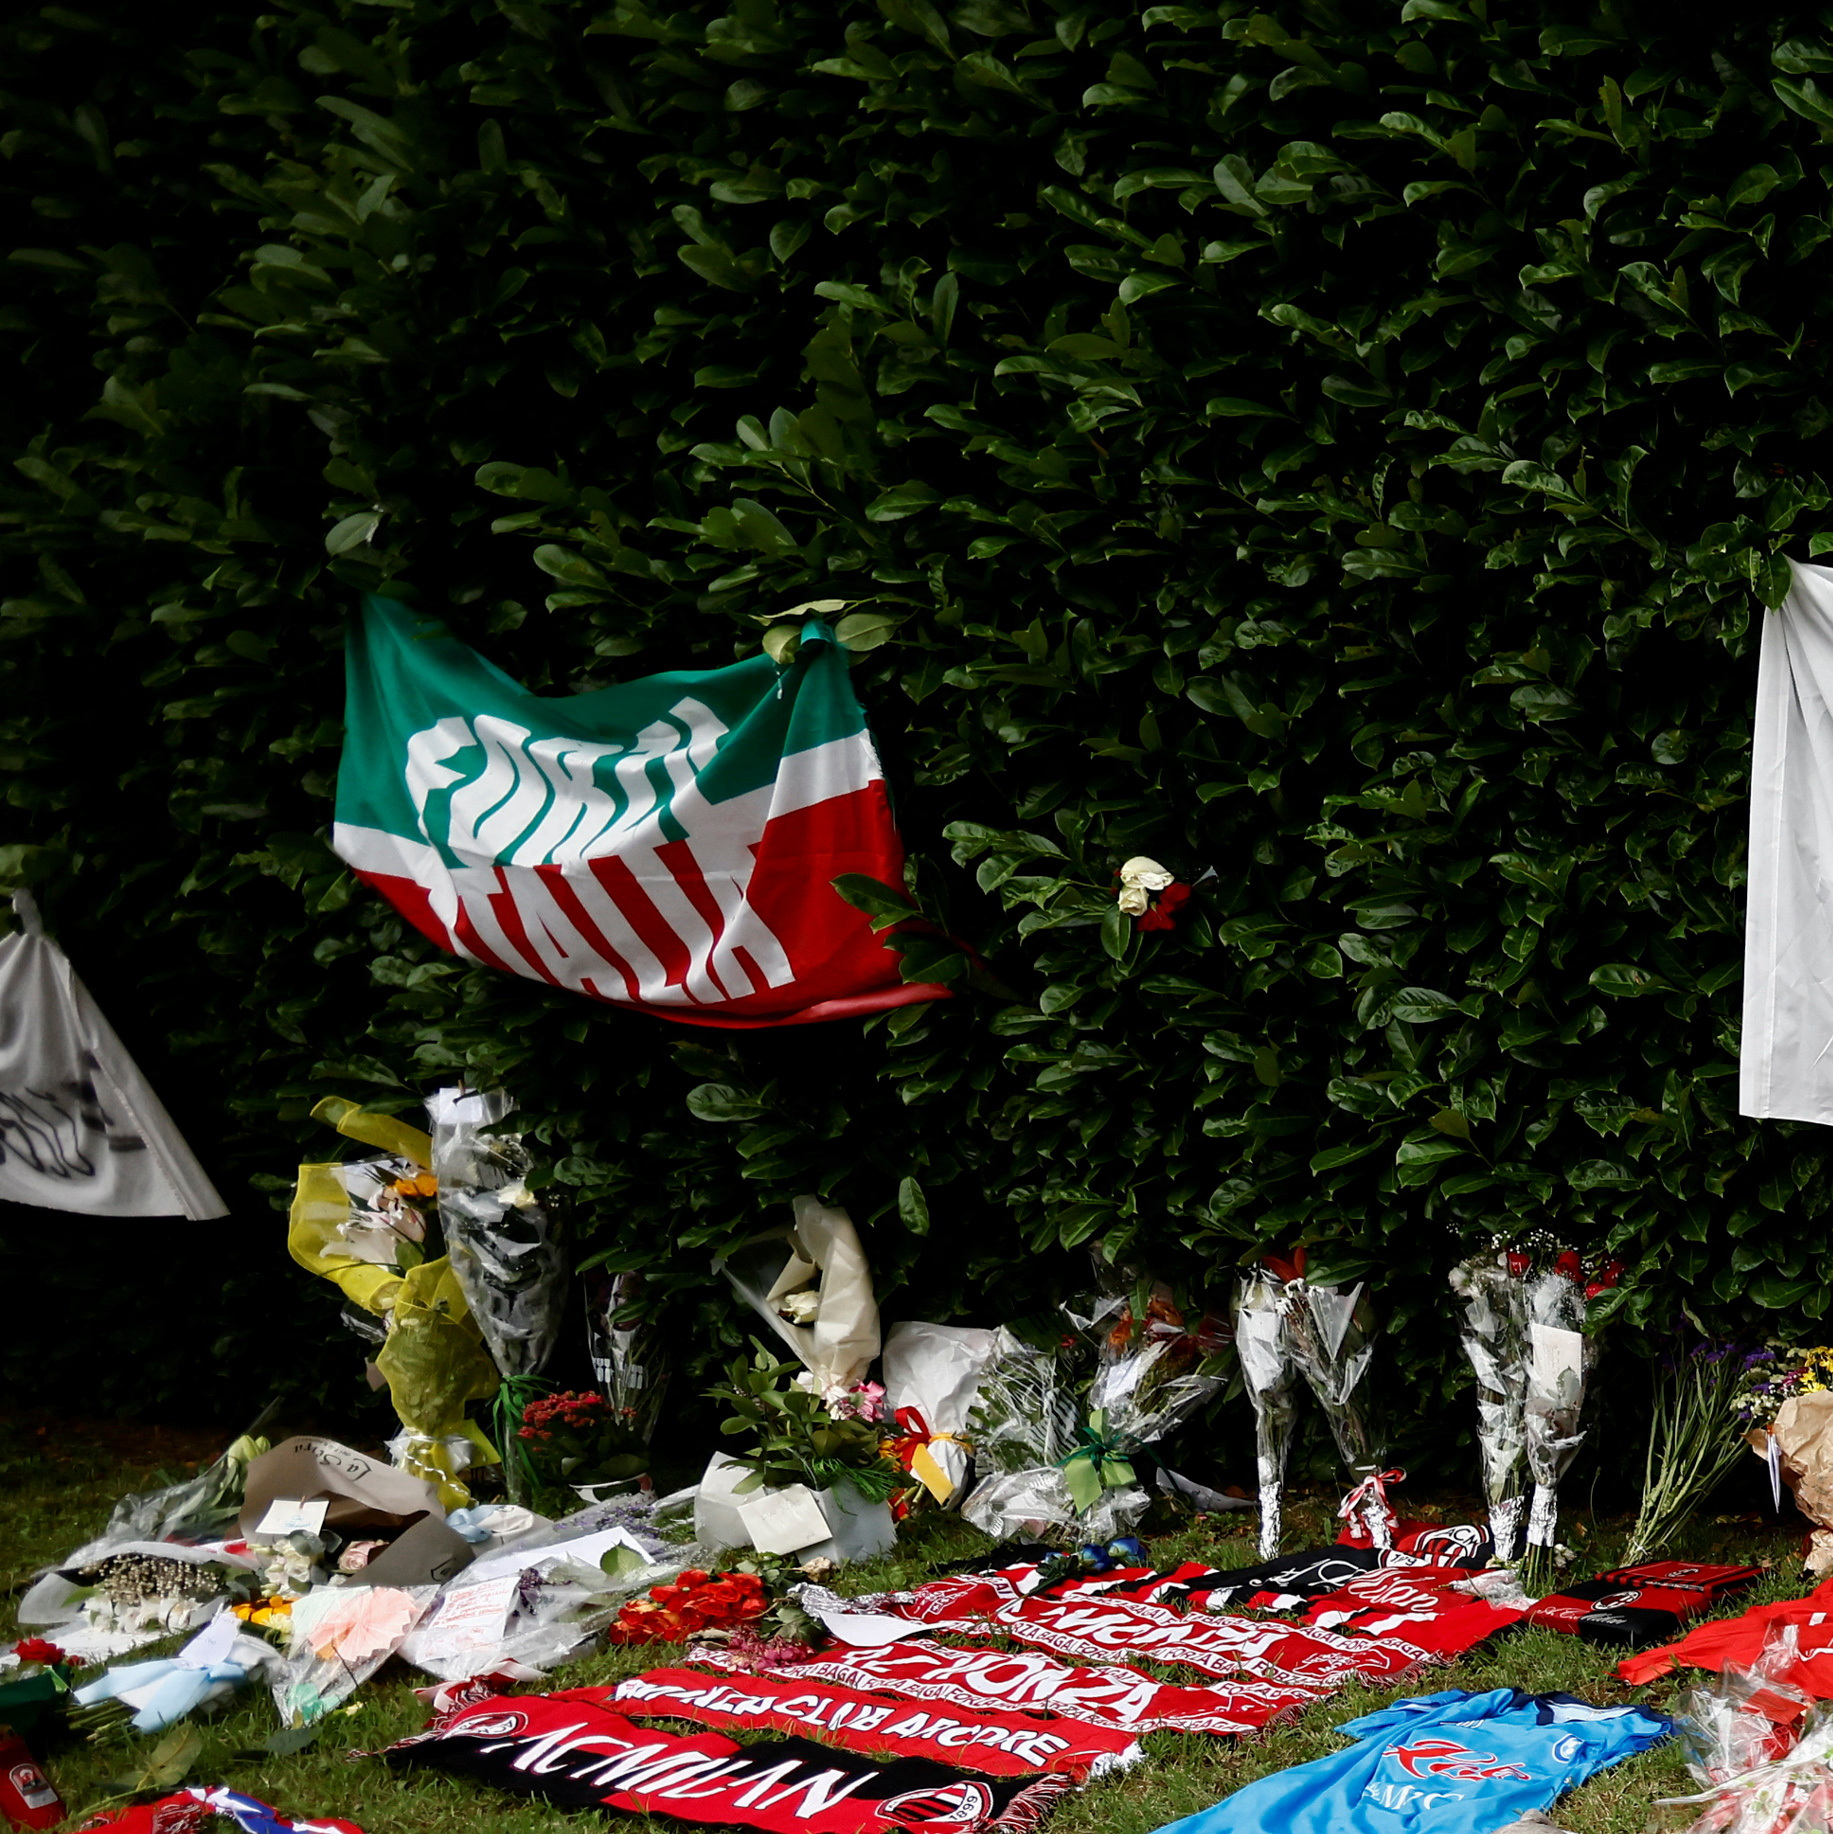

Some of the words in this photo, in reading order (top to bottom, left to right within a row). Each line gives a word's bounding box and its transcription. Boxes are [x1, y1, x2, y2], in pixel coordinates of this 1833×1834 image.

[405, 696, 731, 870] FORZA
[425, 842, 797, 1004] ITALIA
[1440, 1527, 1479, 1547] ACM
[1301, 1626, 1340, 1646] AGAI
[773, 1693, 895, 1732] CLUB
[880, 1710, 1071, 1768] ARCORE
[480, 1721, 635, 1775] AC
[571, 1742, 880, 1820] MILAN
[948, 1794, 979, 1823] 1899
